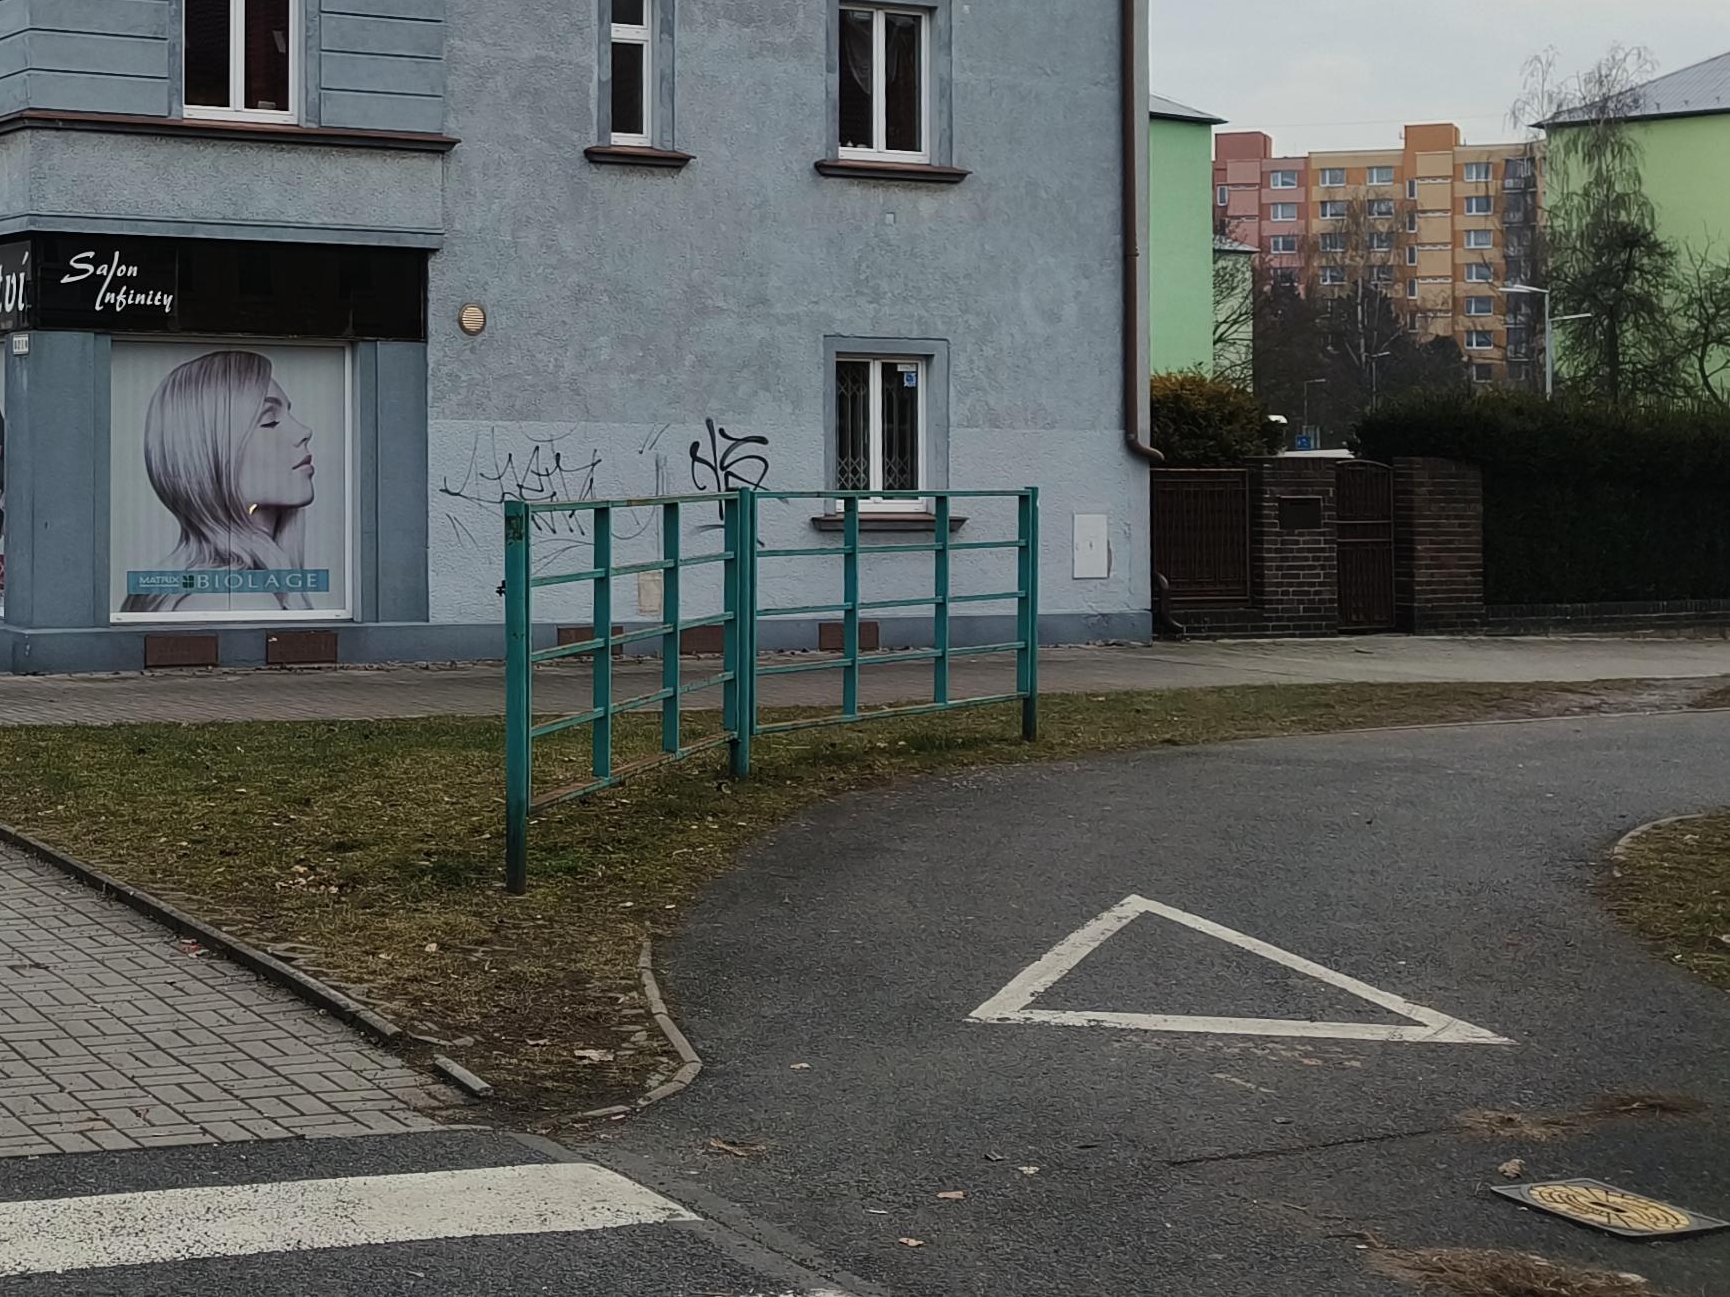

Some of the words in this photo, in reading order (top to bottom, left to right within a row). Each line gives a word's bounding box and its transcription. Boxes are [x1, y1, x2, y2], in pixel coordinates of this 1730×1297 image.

[60, 251, 138, 284] Salon
[95, 285, 174, 313] Infinity
[139, 576, 180, 585] MATRIX
[197, 573, 318, 590] BIOLAGE
